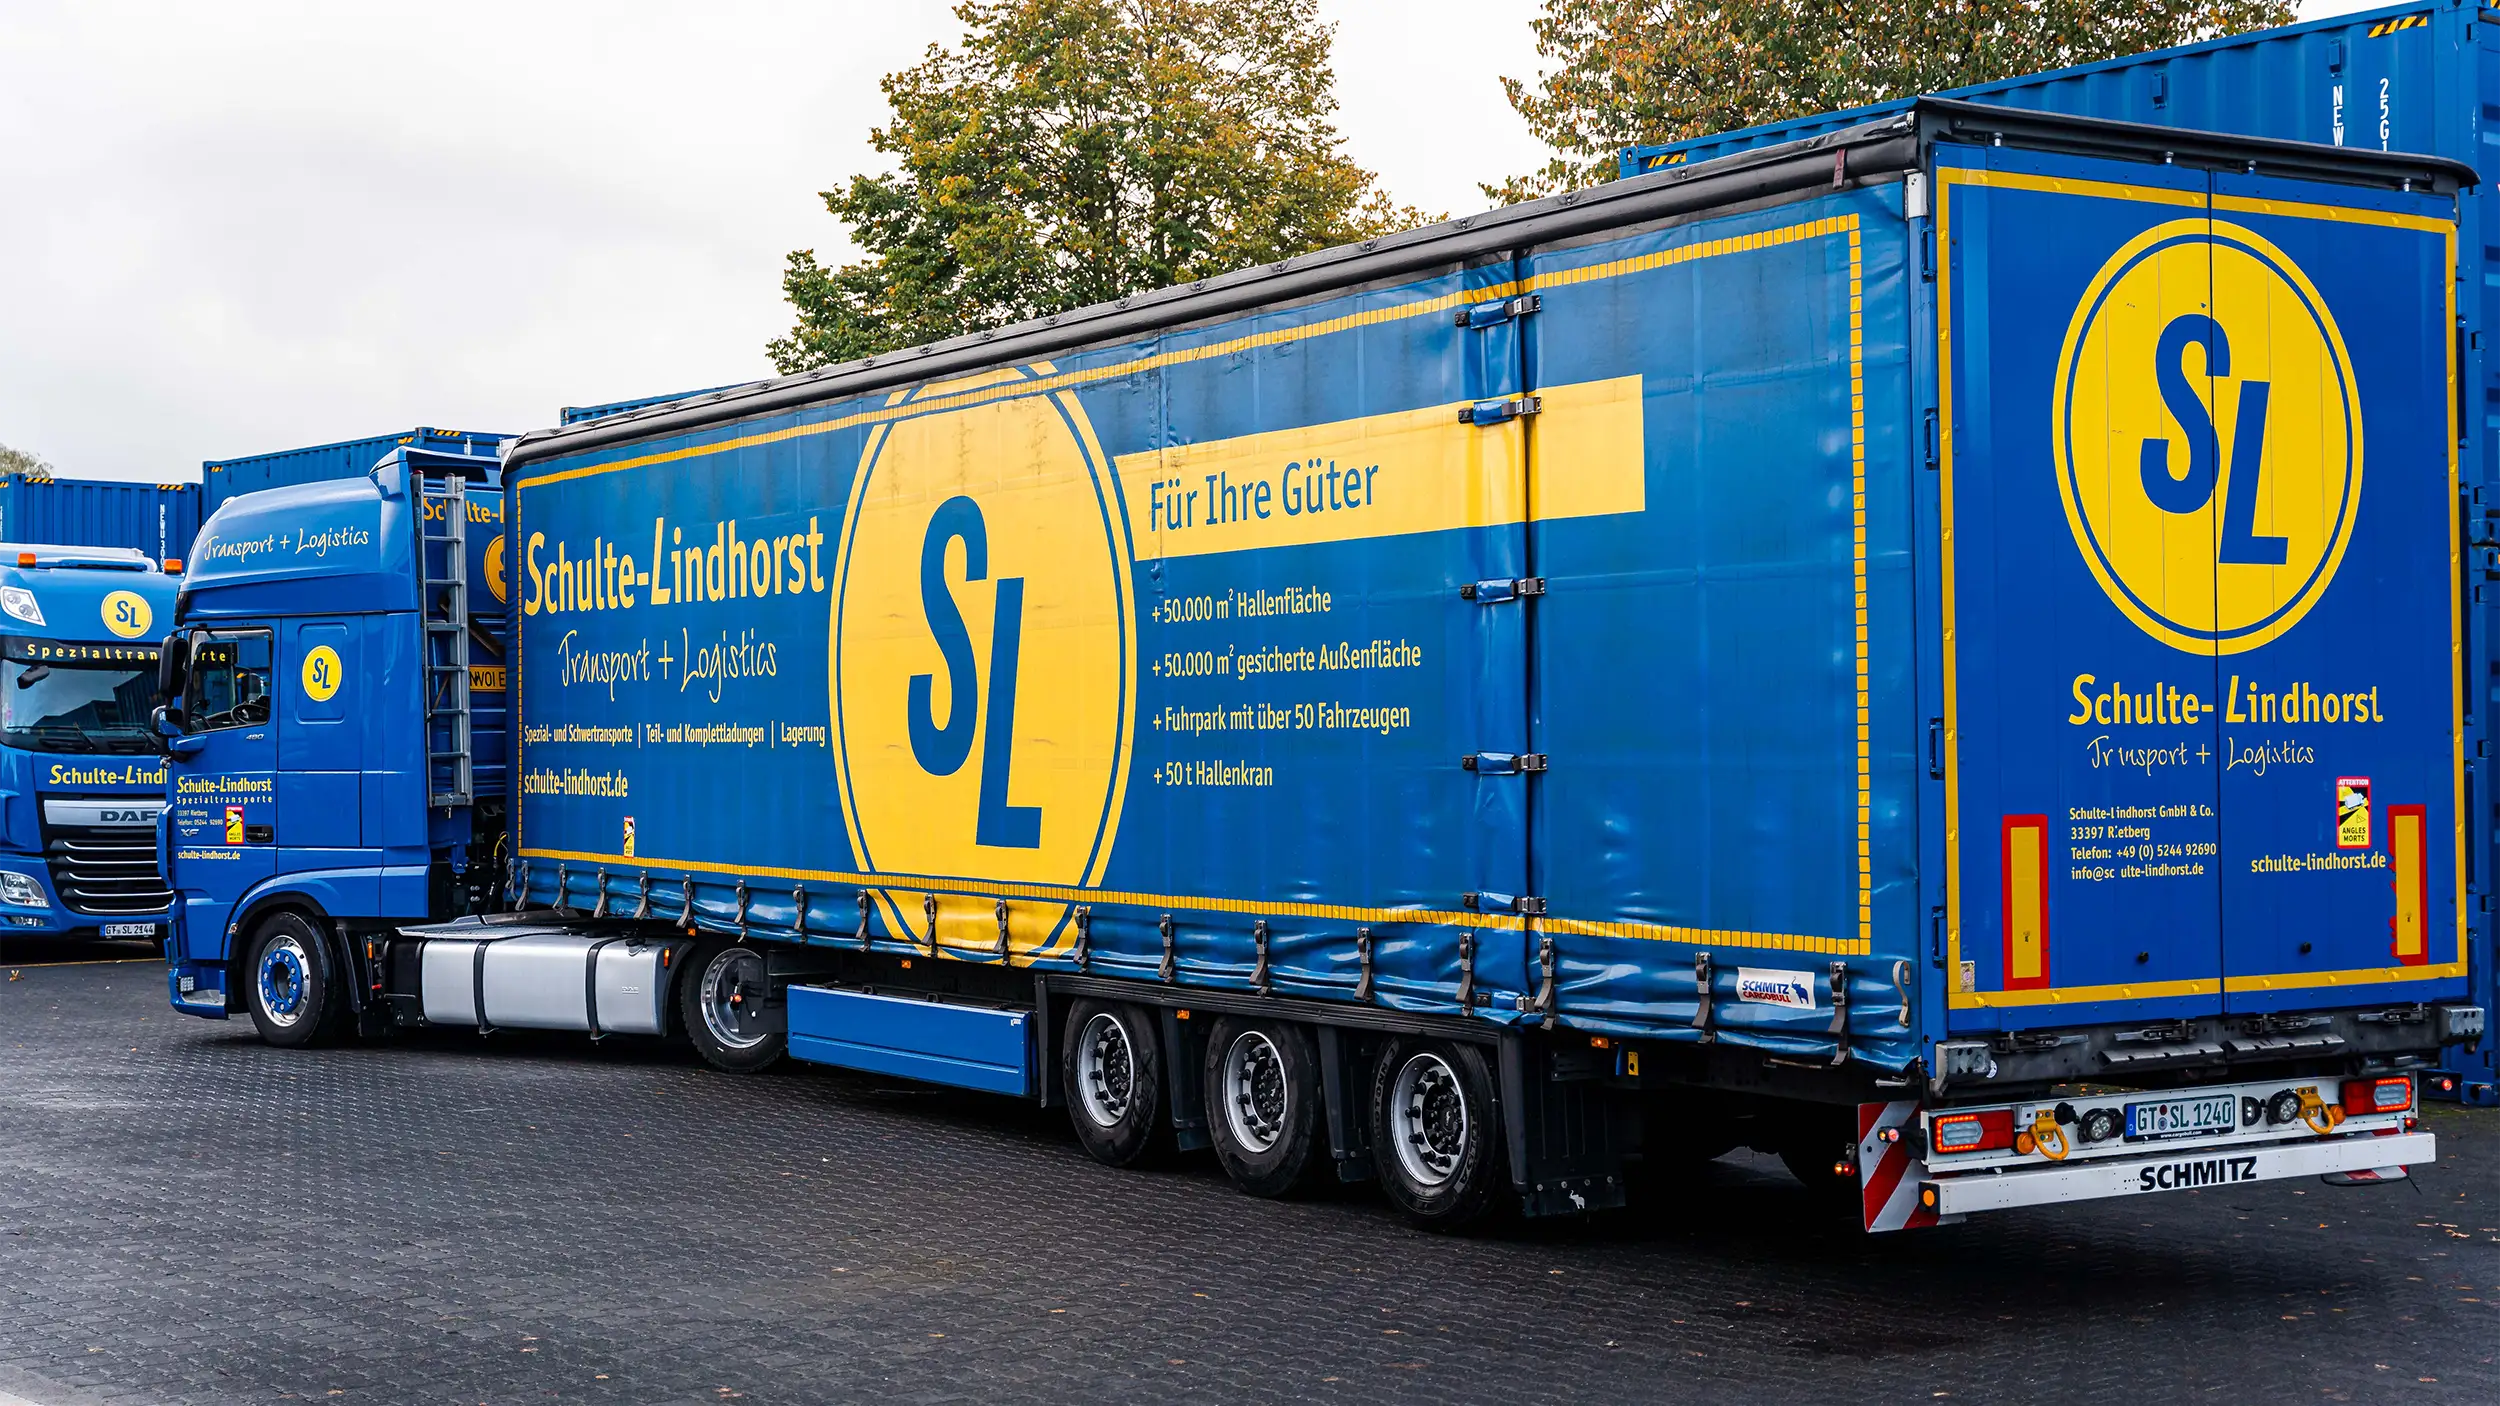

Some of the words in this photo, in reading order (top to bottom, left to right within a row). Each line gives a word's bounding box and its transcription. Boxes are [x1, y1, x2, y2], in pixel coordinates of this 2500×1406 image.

[2140, 313, 2289, 565] SL
[1151, 479, 1197, 531] Für
[1205, 471, 1271, 525] Ihre
[1282, 458, 1379, 516] Güter
[203, 534, 274, 562] Transport
[295, 526, 369, 557] Logistics
[524, 516, 825, 616] Schulte-Lindhorst
[116, 600, 141, 628] SL
[1164, 596, 1213, 623] 50.000
[1237, 585, 1332, 617] Hallenfläche
[312, 657, 331, 689] SL
[559, 629, 650, 702] Transport
[658, 640, 674, 680] +
[680, 627, 777, 704] Logistics
[908, 496, 1042, 849] SL
[1164, 651, 1213, 677] 50.000
[1237, 645, 1315, 681] gesicherte
[1318, 638, 1422, 671] Außenfläche
[1165, 704, 1227, 737] Fuhrpark
[1230, 703, 1254, 730] mit
[1257, 703, 1291, 730] über
[1295, 703, 1315, 730] 50
[1318, 701, 1410, 735] Fahrzeugen
[524, 723, 552, 746] Spezial-
[554, 724, 567, 742] und
[569, 723, 633, 747] Schwertransporte
[646, 723, 664, 743] Teil-
[666, 723, 682, 743] und
[684, 722, 765, 748] Komplettladungen
[781, 722, 826, 748] Lagerung
[177, 775, 272, 794] Schulte-Lindhorst
[524, 767, 629, 798] schulte-lindhorst.de
[1166, 761, 1183, 786] 50
[1185, 762, 1193, 786] t
[1196, 759, 1273, 786] Hallenkran
[176, 795, 273, 806] Spezialtransporte
[2159, 805, 2187, 818] GmbH
[2190, 804, 2197, 817] &
[2200, 804, 2214, 817] Co.
[100, 810, 157, 822] DAF
[181, 828, 200, 837] XF
[2071, 826, 2104, 840] 33397
[2342, 826, 2366, 834] ANGLES
[2343, 834, 2365, 842] MORTS
[177, 850, 241, 860] schulte-lindhorst.de
[2071, 846, 2112, 860] Telefon:
[2116, 845, 2136, 858] +49
[2138, 843, 2154, 861] (0)
[2157, 844, 2182, 857] 5244
[2185, 843, 2217, 856] 92690
[2251, 851, 2387, 873] schulte-lindhorst.de
[1742, 980, 1790, 995] SCHMITZ
[1743, 991, 1792, 1003] CARGOBULL
[2137, 1107, 2157, 1131] GT
[2170, 1104, 2190, 1129] SL
[2193, 1101, 2232, 1127] 1240
[2140, 1155, 2257, 1192] SCHMITZ
